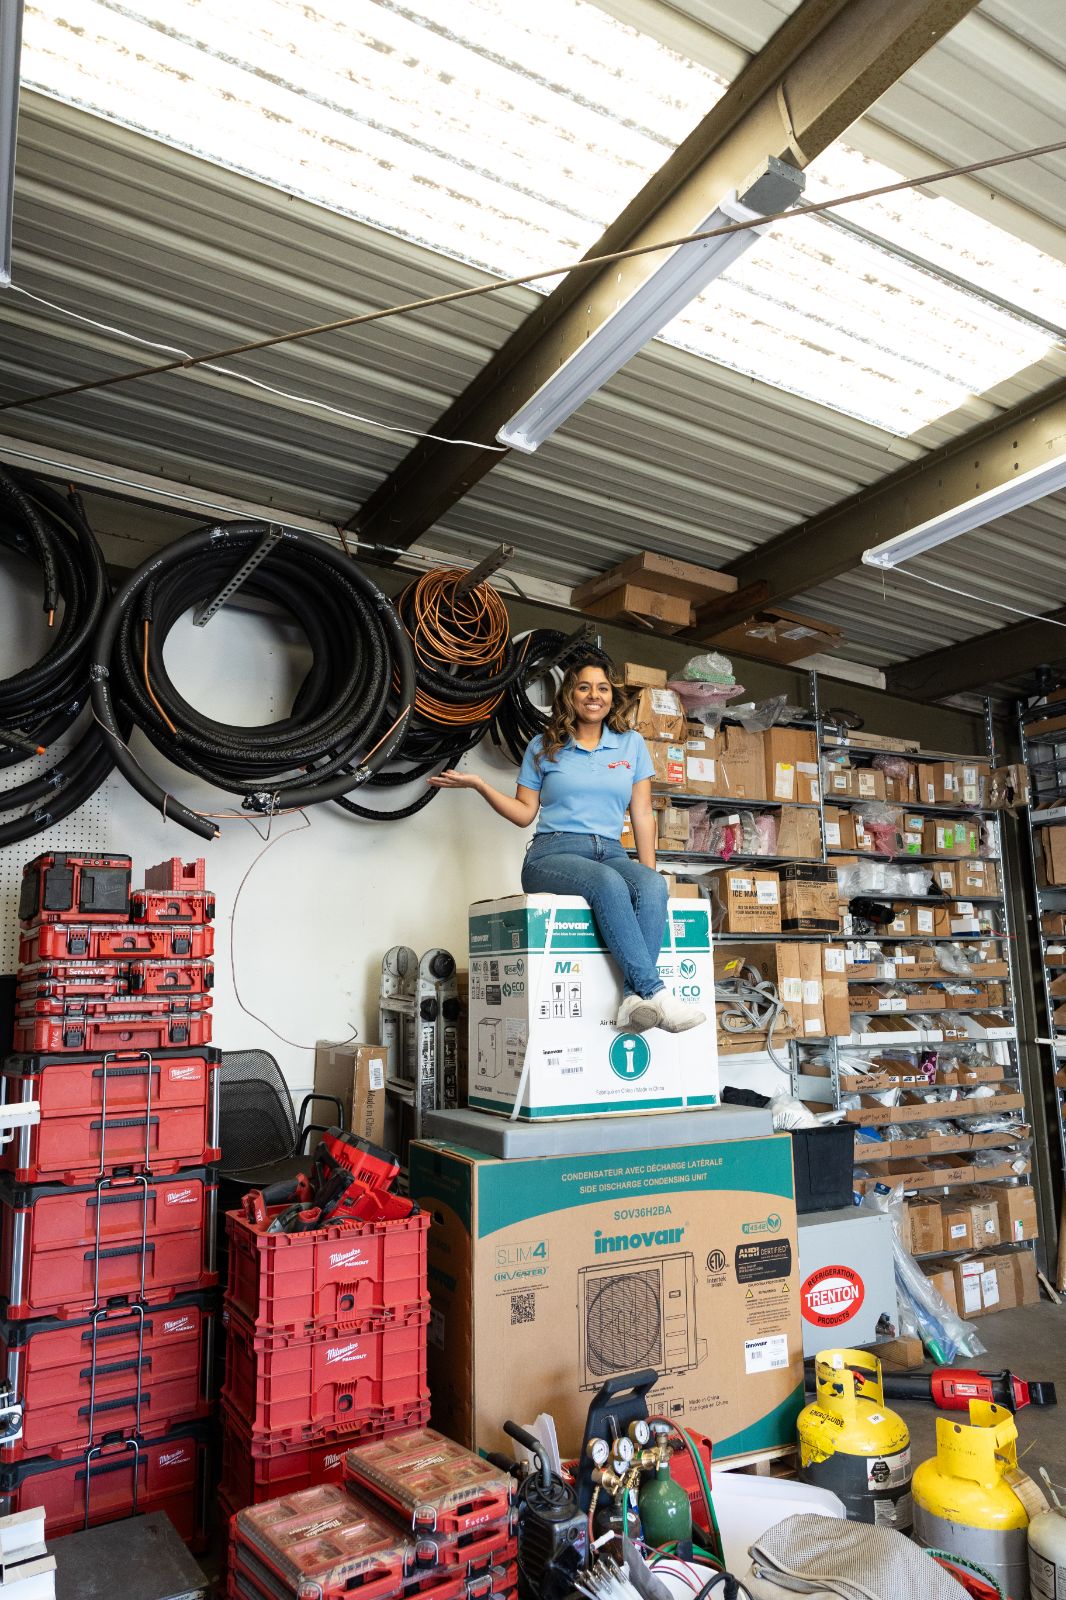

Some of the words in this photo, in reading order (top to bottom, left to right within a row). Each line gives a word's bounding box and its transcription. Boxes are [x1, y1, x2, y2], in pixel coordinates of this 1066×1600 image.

[554, 962, 580, 974] M4
[512, 982, 524, 991] ECO
[366, 1090, 376, 1108] Made
[562, 1168, 624, 1181] CONDENSATEUR
[626, 1166, 645, 1175] AVEC
[646, 1161, 686, 1173] DÉCHARGE
[688, 1158, 723, 1168] LATÉRALE
[598, 1180, 642, 1192] DISCHARGE
[643, 1175, 690, 1187] CONDENSING
[692, 1173, 708, 1182] UNIT
[614, 1205, 672, 1220] SOV36H2BA
[594, 1227, 684, 1254] innovair
[329, 1248, 361, 1265] Milwaukee
[761, 1246, 786, 1255] CERTIFIED
[808, 1269, 854, 1287] REFRIGERATION
[805, 1285, 859, 1307] TRENTON
[818, 1311, 849, 1324] PRODUCTS
[325, 1342, 358, 1360] Milwaukee
[465, 1514, 489, 1527] Fuses
